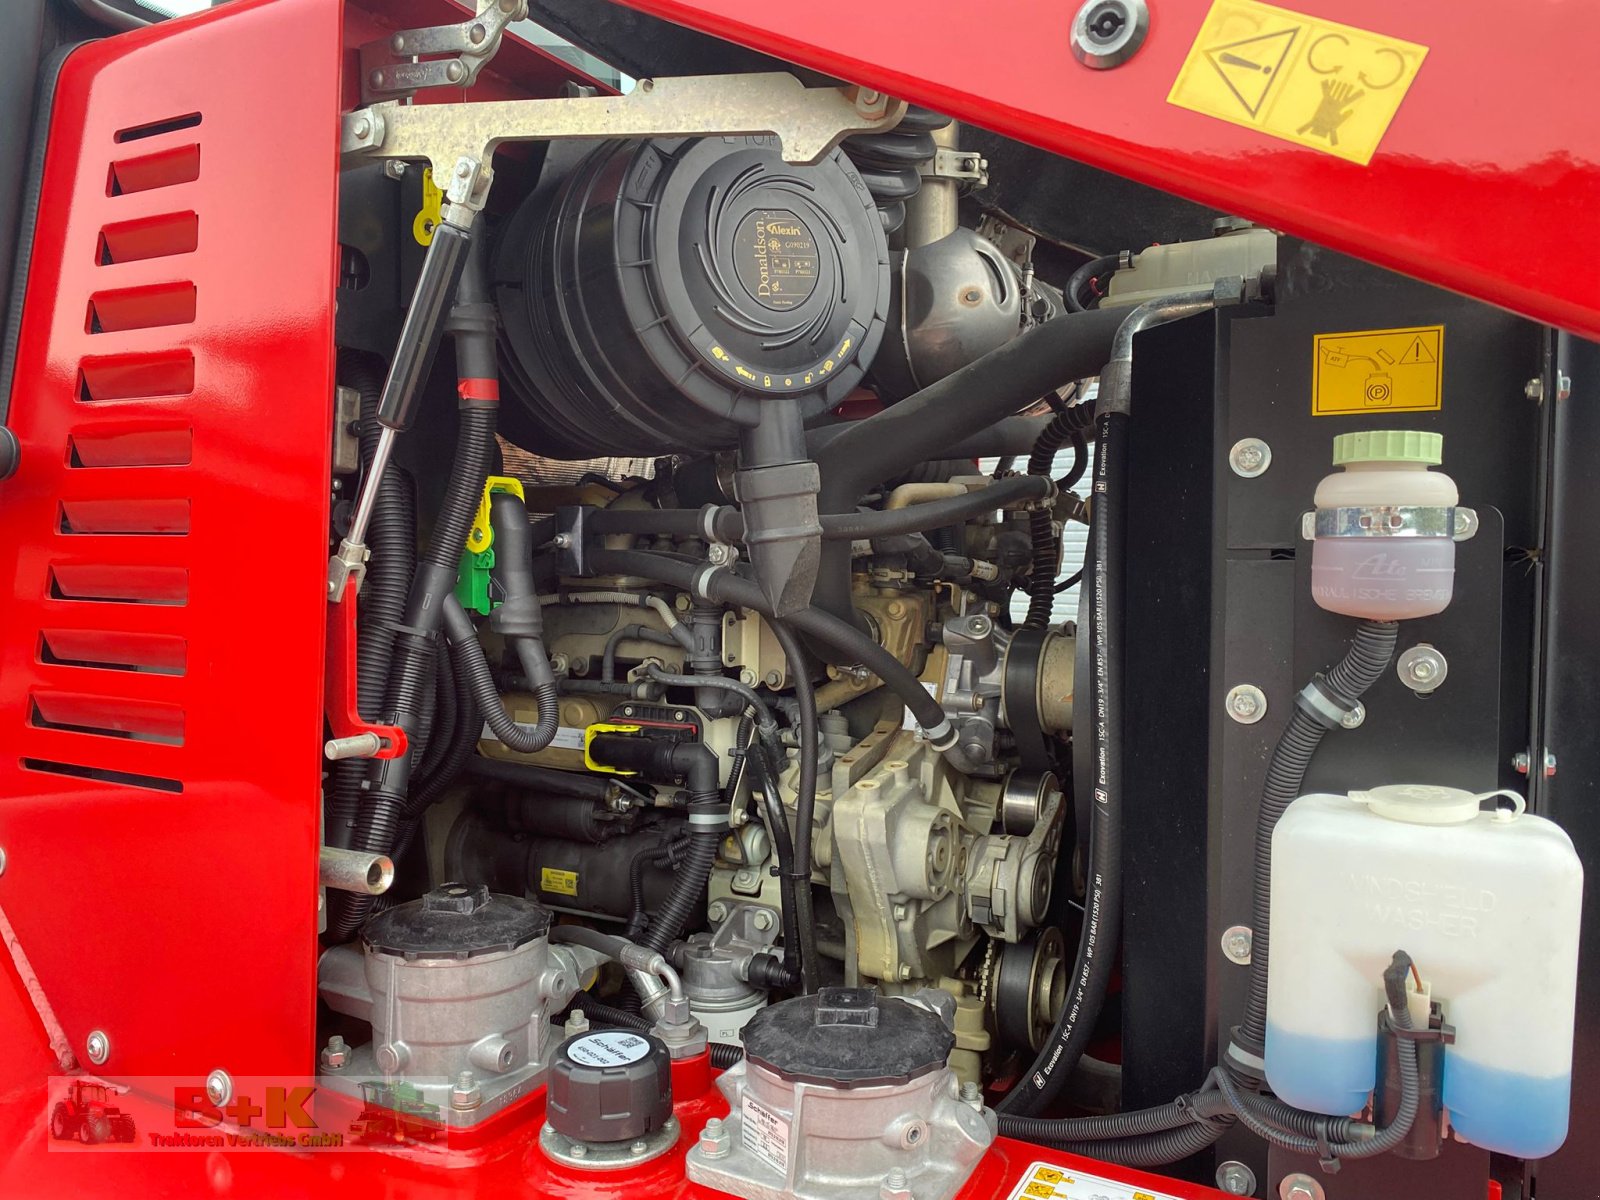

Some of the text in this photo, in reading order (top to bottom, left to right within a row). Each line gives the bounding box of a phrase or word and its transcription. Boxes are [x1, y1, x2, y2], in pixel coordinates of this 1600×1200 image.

[1374, 388, 1383, 397] P
[1099, 442, 1108, 476] Exovation
[1096, 634, 1103, 646] WP
[1096, 653, 1104, 666] 857
[1097, 666, 1104, 677] EN
[1095, 873, 1103, 886] 381
[1093, 889, 1101, 904] PSI)
[1092, 903, 1100, 922] (1520
[1090, 920, 1098, 936] BAR
[1088, 935, 1096, 948] 105
[1086, 947, 1094, 959] WP
[1082, 964, 1090, 976] 857
[1079, 975, 1087, 987] EN
[1069, 1003, 1080, 1023] DN19
[1044, 1044, 1064, 1076] Exovation
